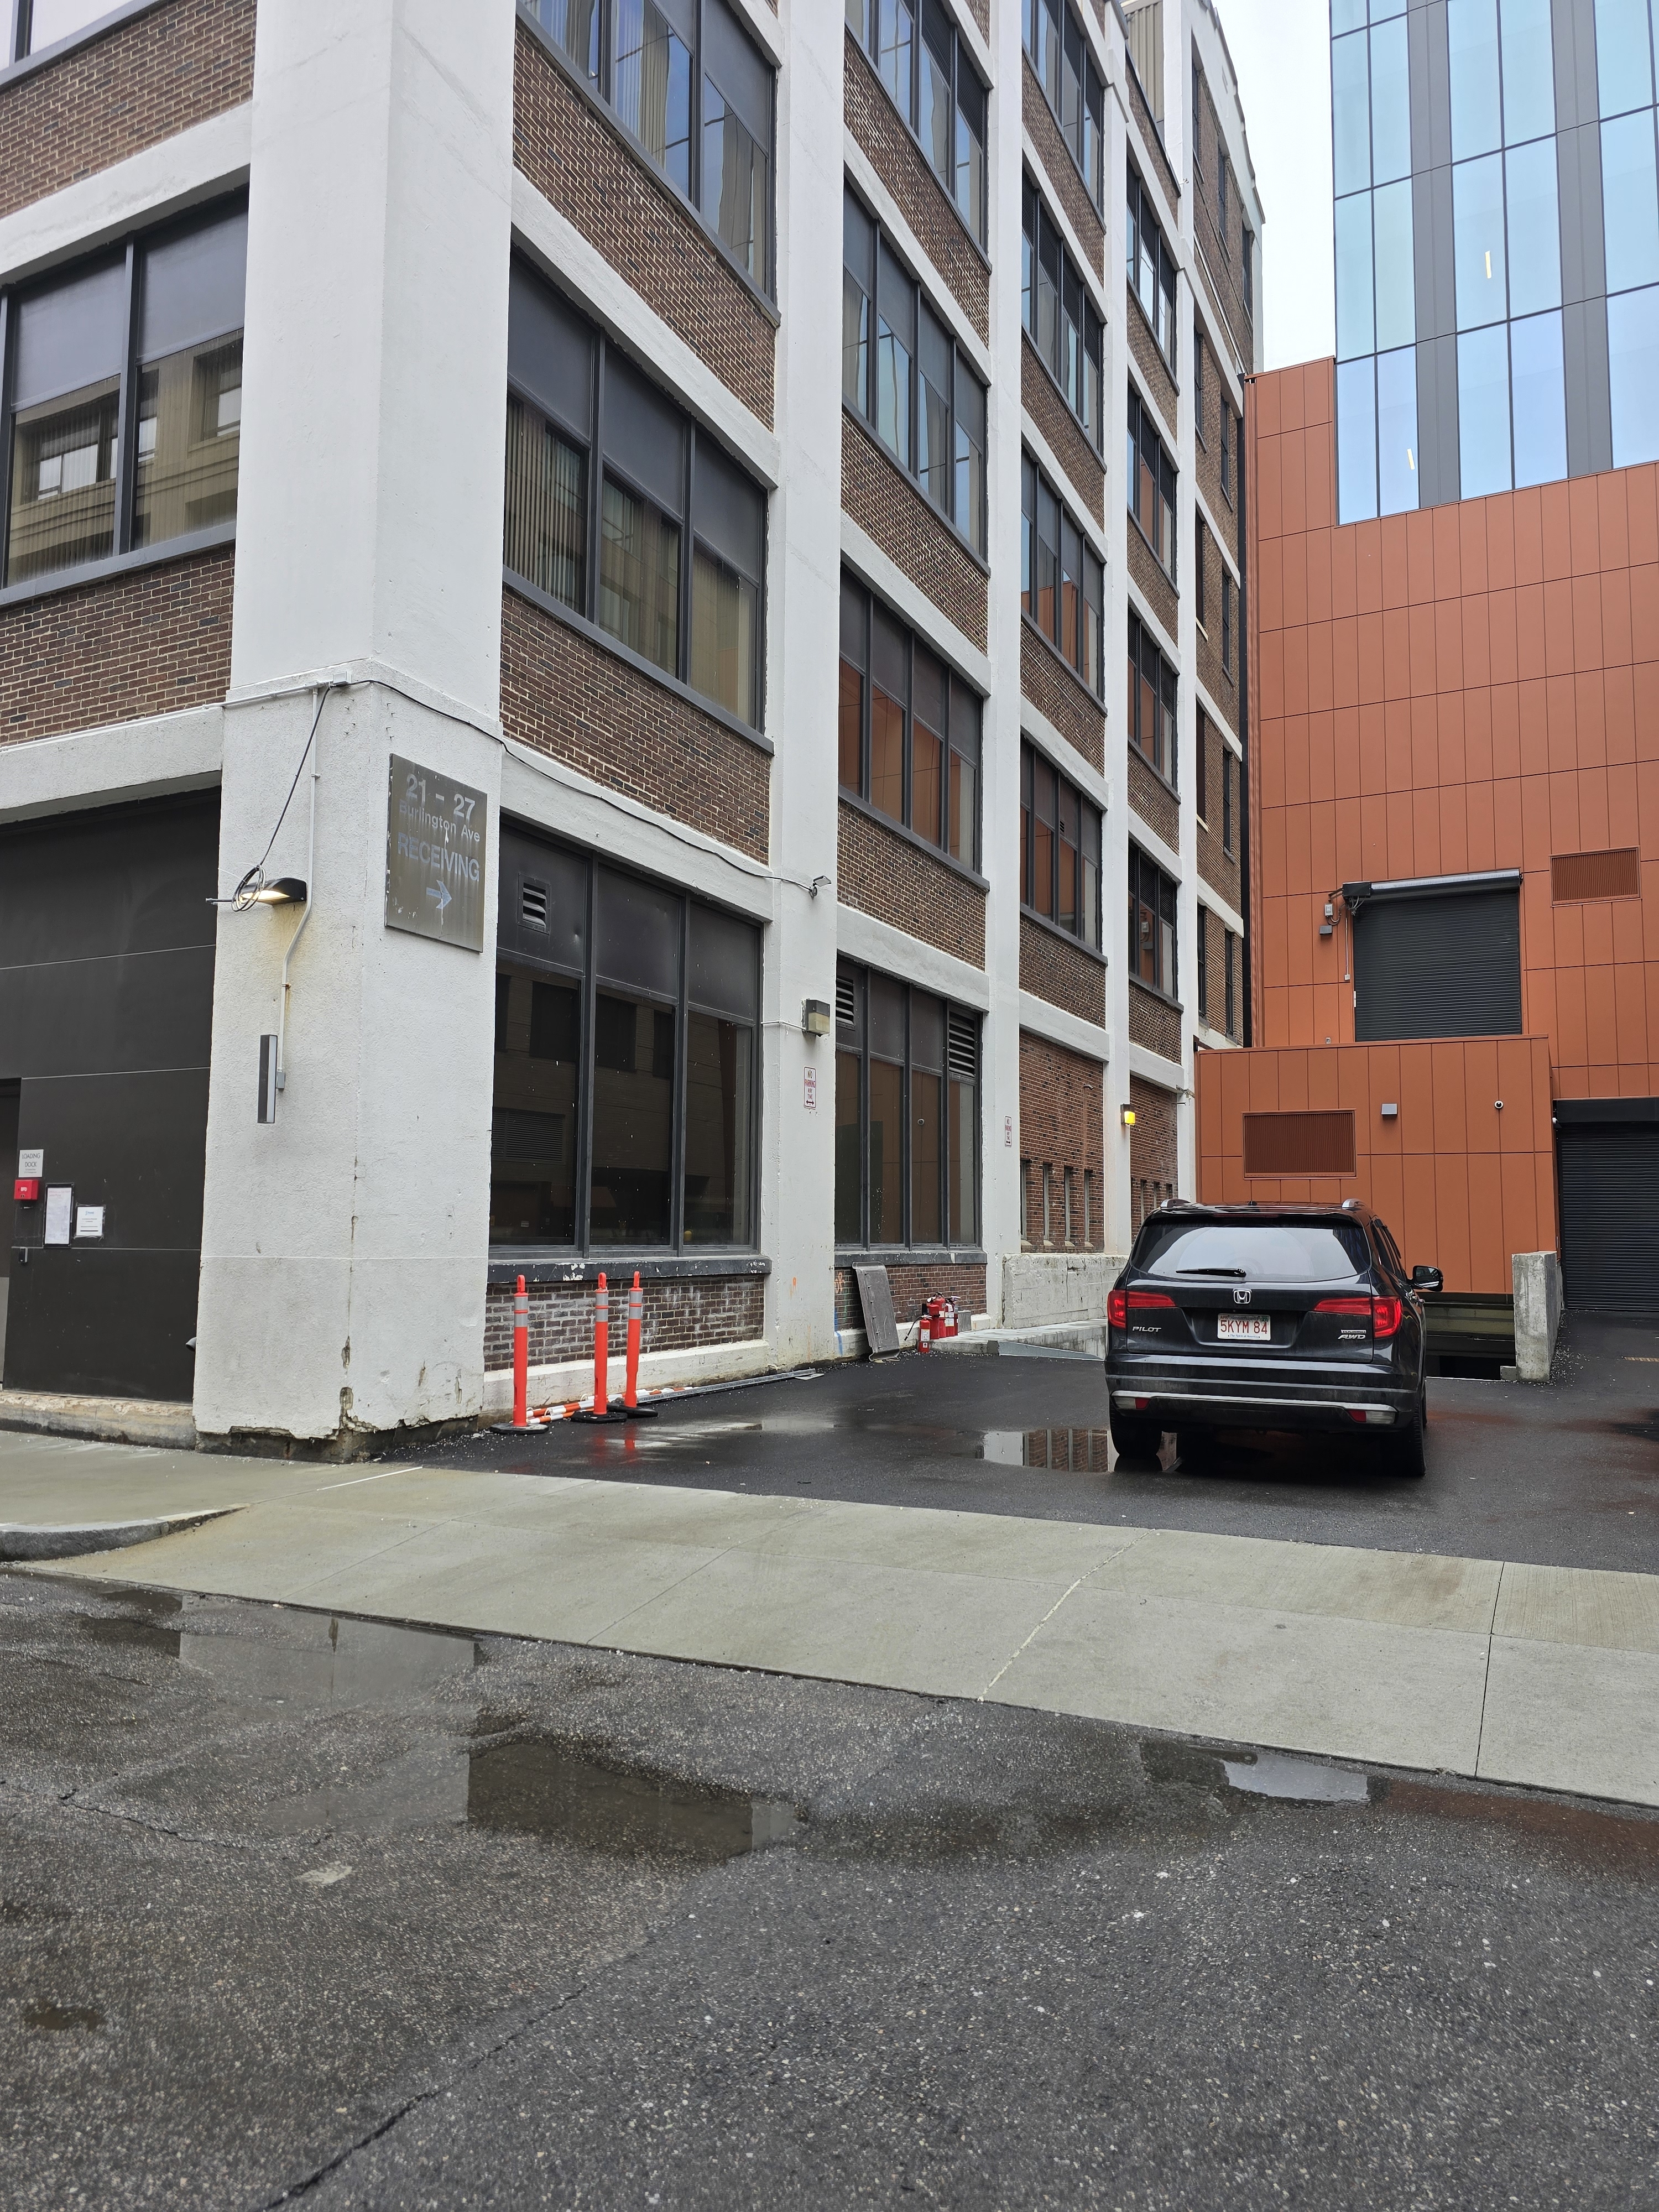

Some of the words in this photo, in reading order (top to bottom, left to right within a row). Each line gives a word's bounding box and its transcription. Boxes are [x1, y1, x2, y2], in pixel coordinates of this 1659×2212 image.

[406, 774, 426, 803] 21
[453, 794, 476, 820] 27
[399, 799, 456, 833] Burlington
[461, 824, 481, 843] Ave
[398, 832, 480, 882] RECEIVING
[805, 1079, 816, 1088] PARKING
[807, 1070, 812, 1078] NO
[1220, 1320, 1249, 1333] 5KYM
[1254, 1321, 1267, 1334] 84
